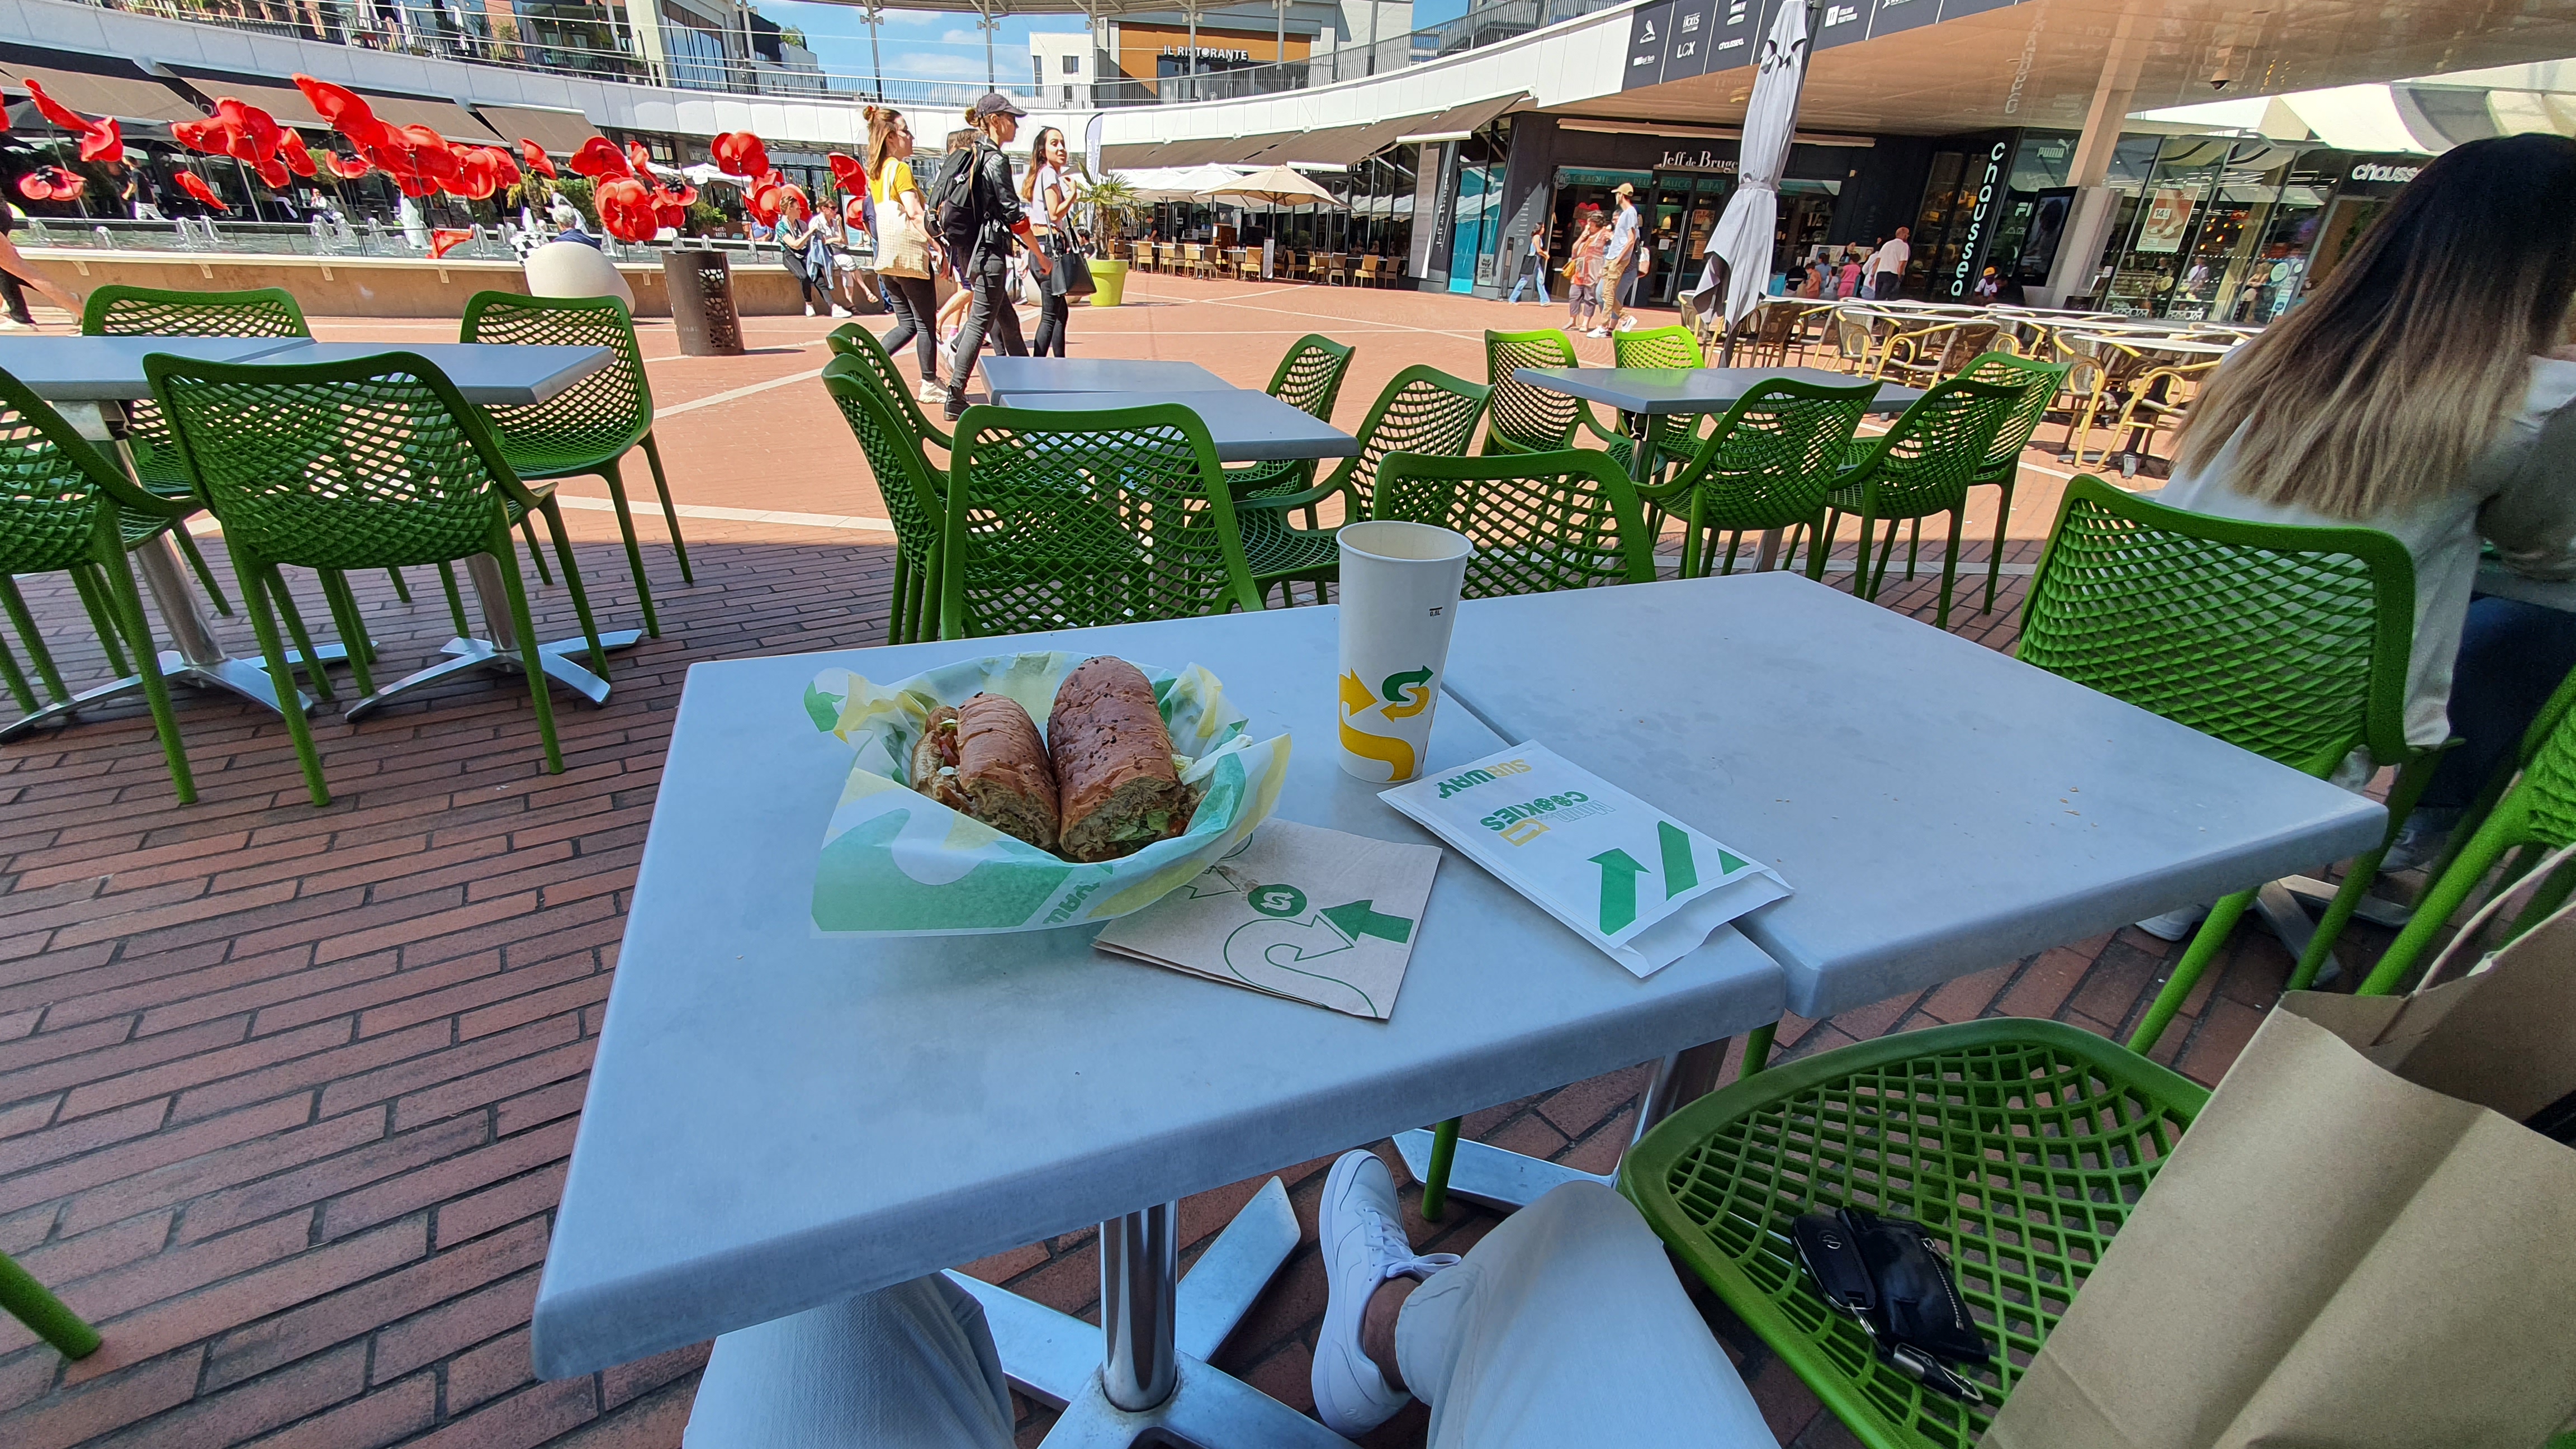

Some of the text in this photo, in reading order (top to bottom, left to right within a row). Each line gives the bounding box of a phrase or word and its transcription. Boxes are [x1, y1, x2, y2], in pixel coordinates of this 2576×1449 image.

[1163, 45, 1248, 60] IL RITORANTE
[1659, 150, 1739, 174] Jeff de Bruge
[2037, 146, 2064, 158] PUMA
[2351, 162, 2419, 182] chauss
[1437, 759, 1532, 799] SUBWAY
[1480, 790, 1589, 831] COOKIES
